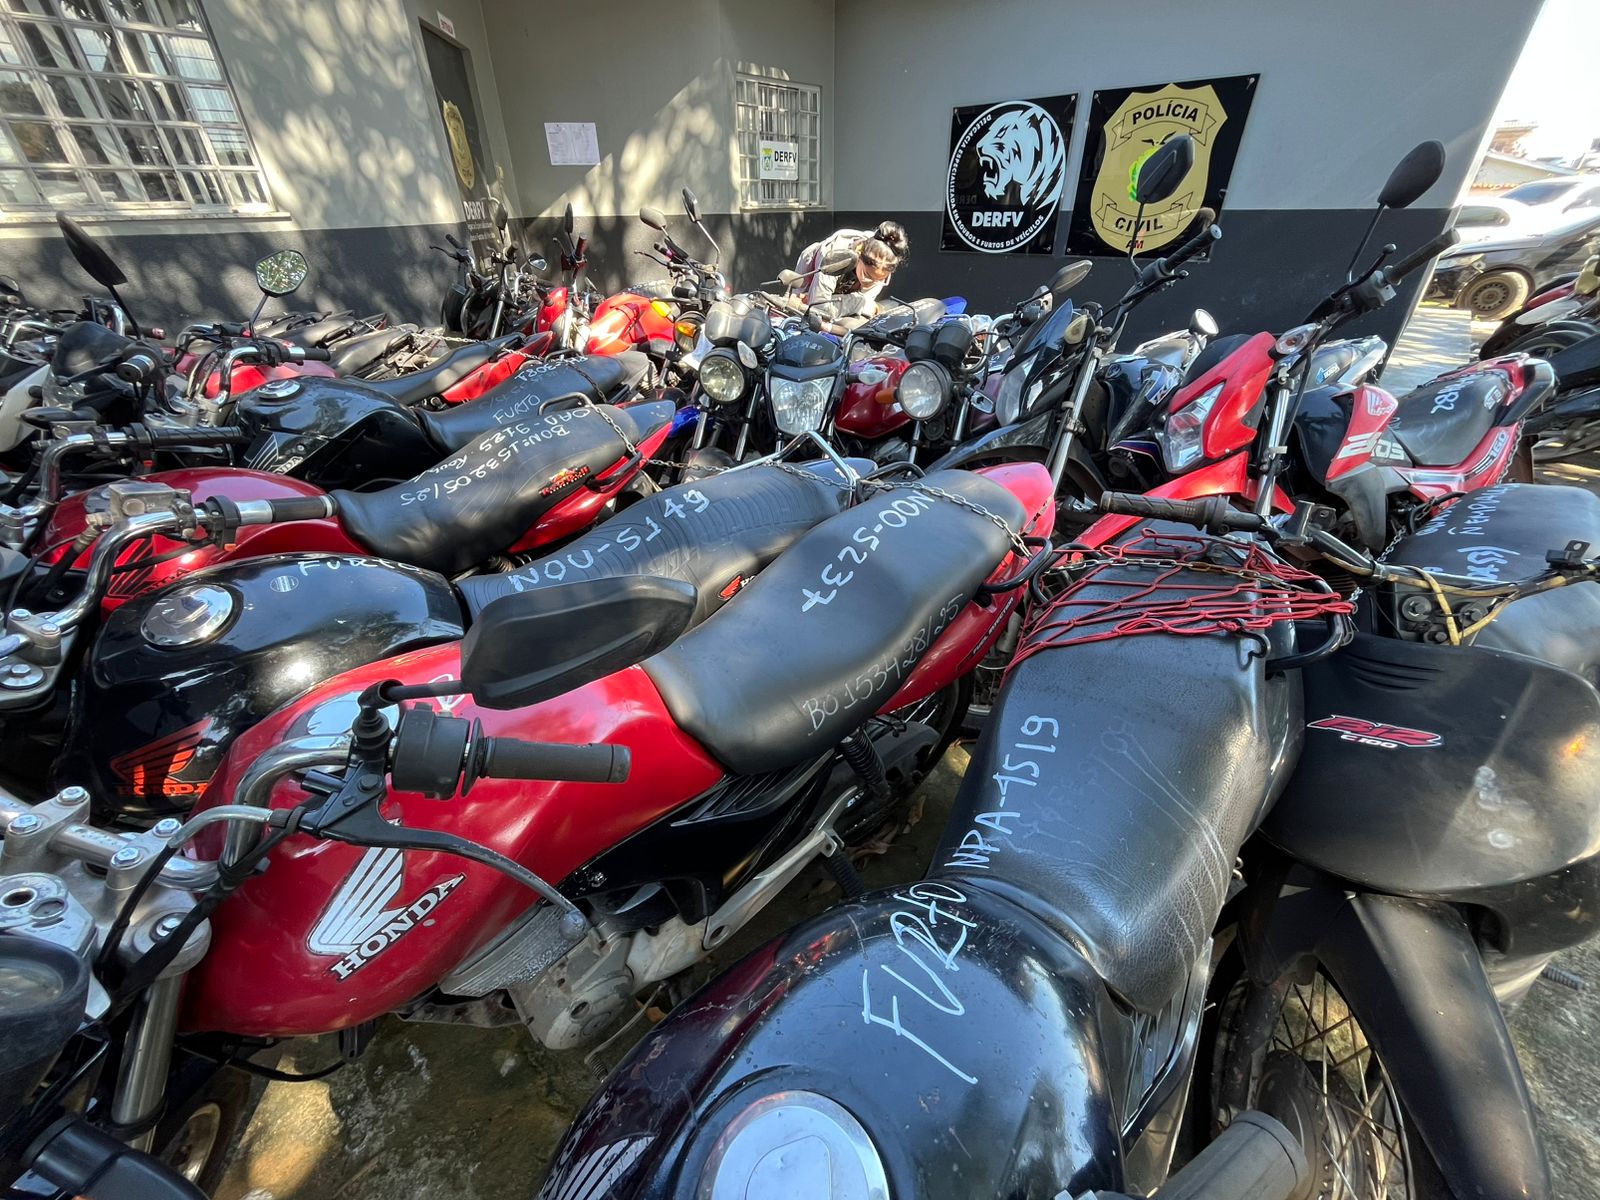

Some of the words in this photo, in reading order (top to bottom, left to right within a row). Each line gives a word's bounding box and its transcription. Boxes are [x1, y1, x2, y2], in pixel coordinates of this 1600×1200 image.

[1131, 100, 1200, 125] POLÍCIA
[774, 150, 797, 163] DERFV
[956, 218, 977, 242] ROUBOS
[980, 240, 1005, 249] FURTOS
[1015, 214, 1045, 243] VEÍCULOS
[971, 211, 1025, 227] DERFV
[1115, 217, 1164, 231] CIVIL
[1306, 714, 1444, 748] BIZ
[330, 873, 466, 981] HONDA
[861, 881, 979, 1085] FURTO
